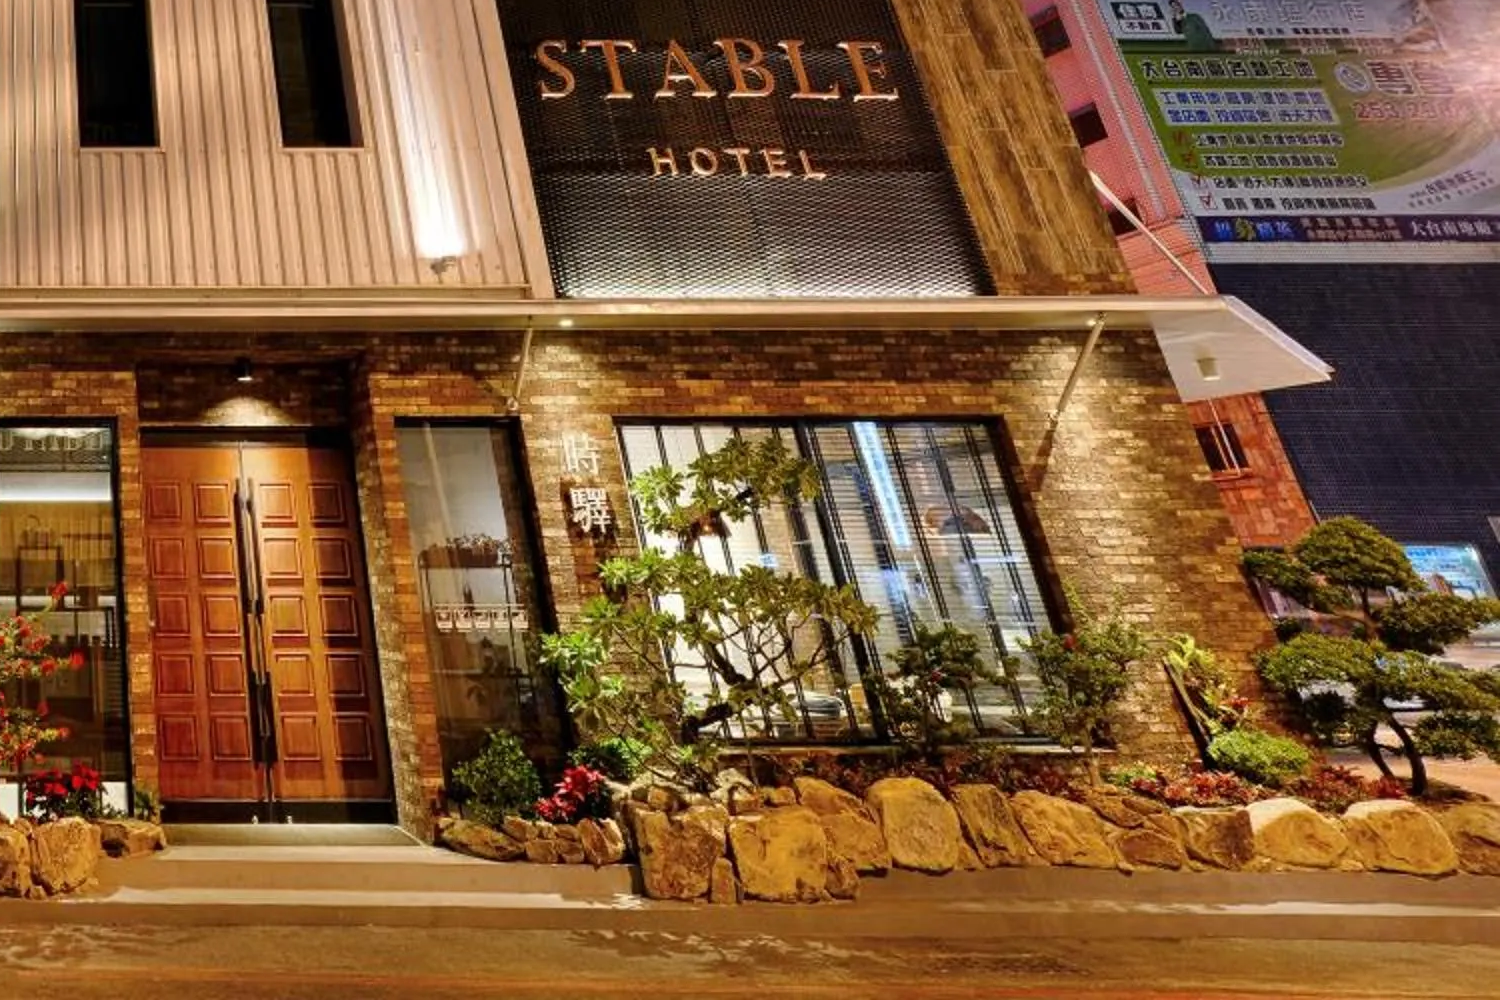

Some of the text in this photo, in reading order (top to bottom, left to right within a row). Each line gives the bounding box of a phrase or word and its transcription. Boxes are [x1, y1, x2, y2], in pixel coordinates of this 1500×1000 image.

[534, 39, 899, 102] STABLE
[647, 147, 828, 181] HOTEL
[562, 431, 611, 534] 時驛
